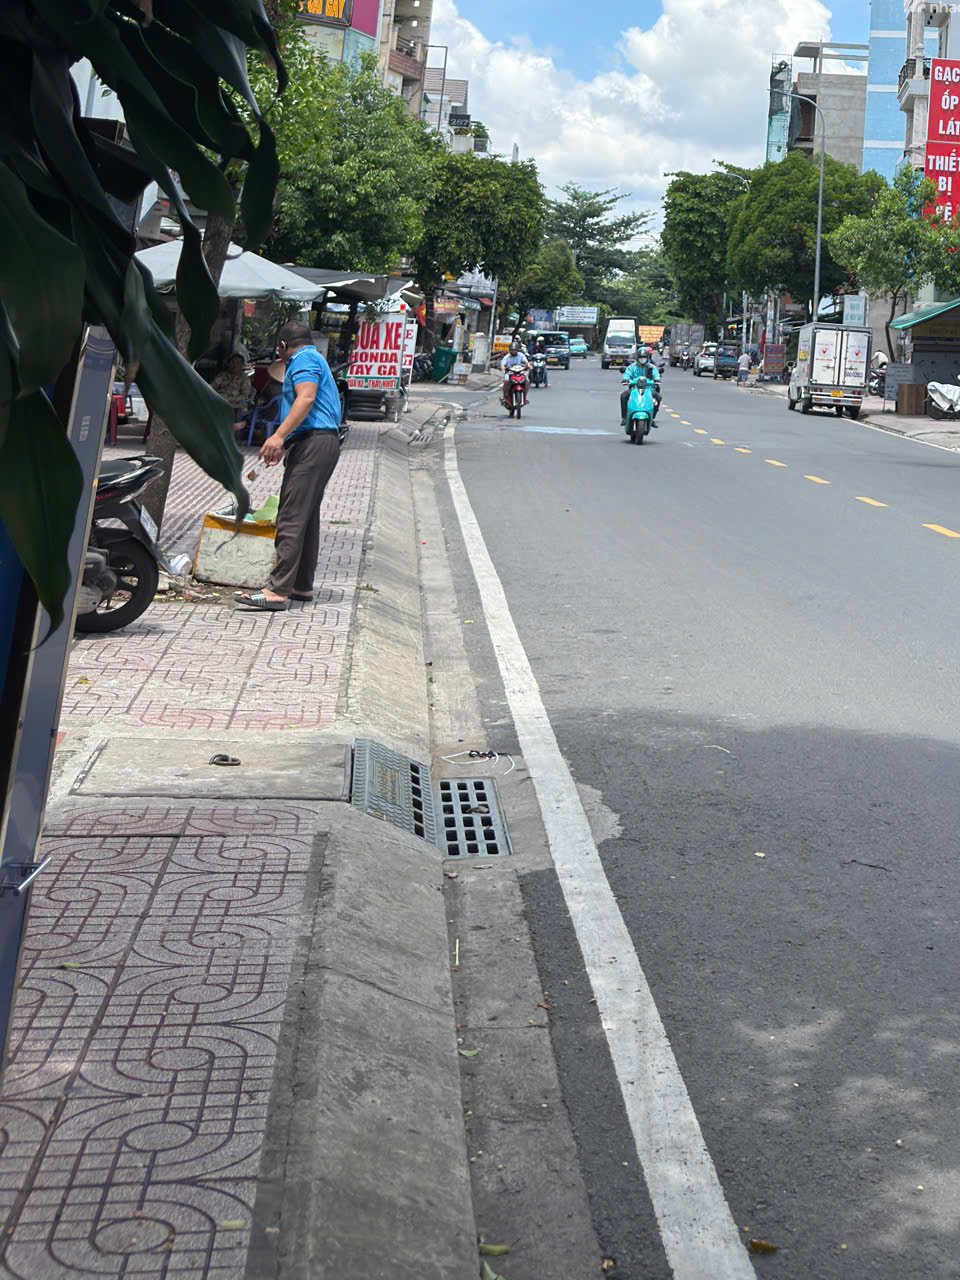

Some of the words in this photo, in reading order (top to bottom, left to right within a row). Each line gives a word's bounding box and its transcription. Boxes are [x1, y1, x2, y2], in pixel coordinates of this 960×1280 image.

[941, 90, 959, 110] ỐP
[938, 176, 952, 196] BỊ
[383, 322, 403, 351] XE
[348, 351, 399, 364] HONDA
[349, 364, 374, 376] TAY
[377, 365, 398, 376] GA
